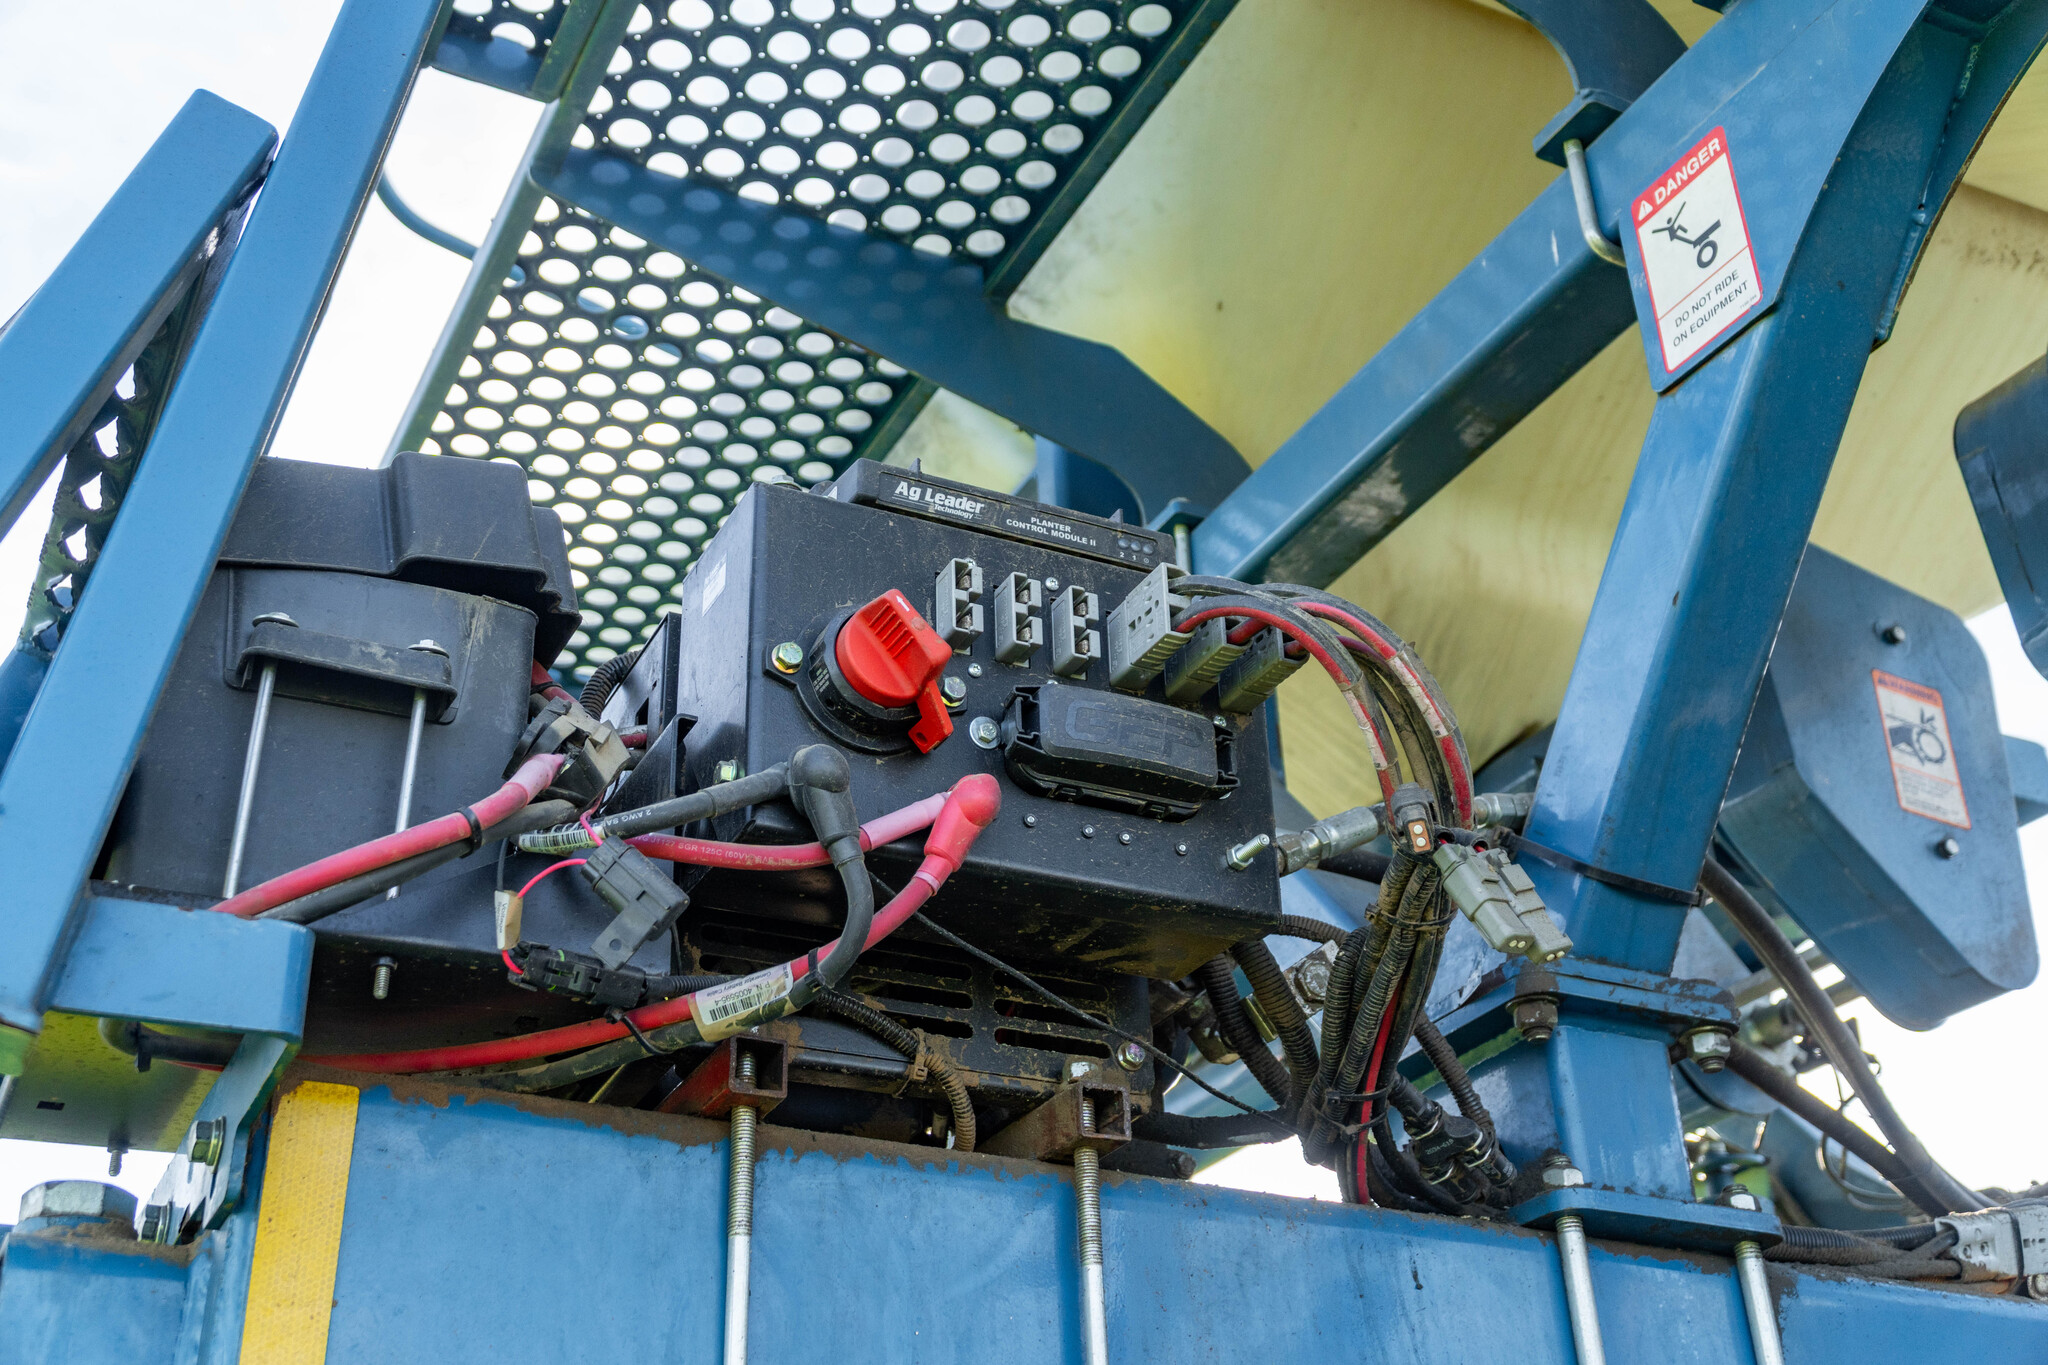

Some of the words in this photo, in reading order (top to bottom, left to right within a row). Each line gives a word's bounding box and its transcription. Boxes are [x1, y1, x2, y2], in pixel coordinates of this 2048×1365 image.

[1654, 137, 1721, 205] DANGER
[1674, 308, 1690, 328] DO
[1691, 291, 1713, 314] NOT
[1714, 268, 1740, 295] RIDE
[1672, 328, 1689, 348] ON
[1689, 279, 1750, 335] EQUIPMENT
[894, 481, 922, 501] Ag
[924, 487, 985, 514] Leader
[934, 503, 974, 520] Technology
[1006, 518, 1050, 535] CONTROL
[1050, 529, 1088, 545] MODULE
[1030, 516, 1072, 533] PLANTER
[621, 810, 644, 822] AWG
[650, 837, 676, 848] J1127
[677, 841, 699, 851] SGR
[701, 846, 723, 856] 125C
[743, 971, 772, 985] Generator
[714, 987, 753, 1006] 4005595-4
